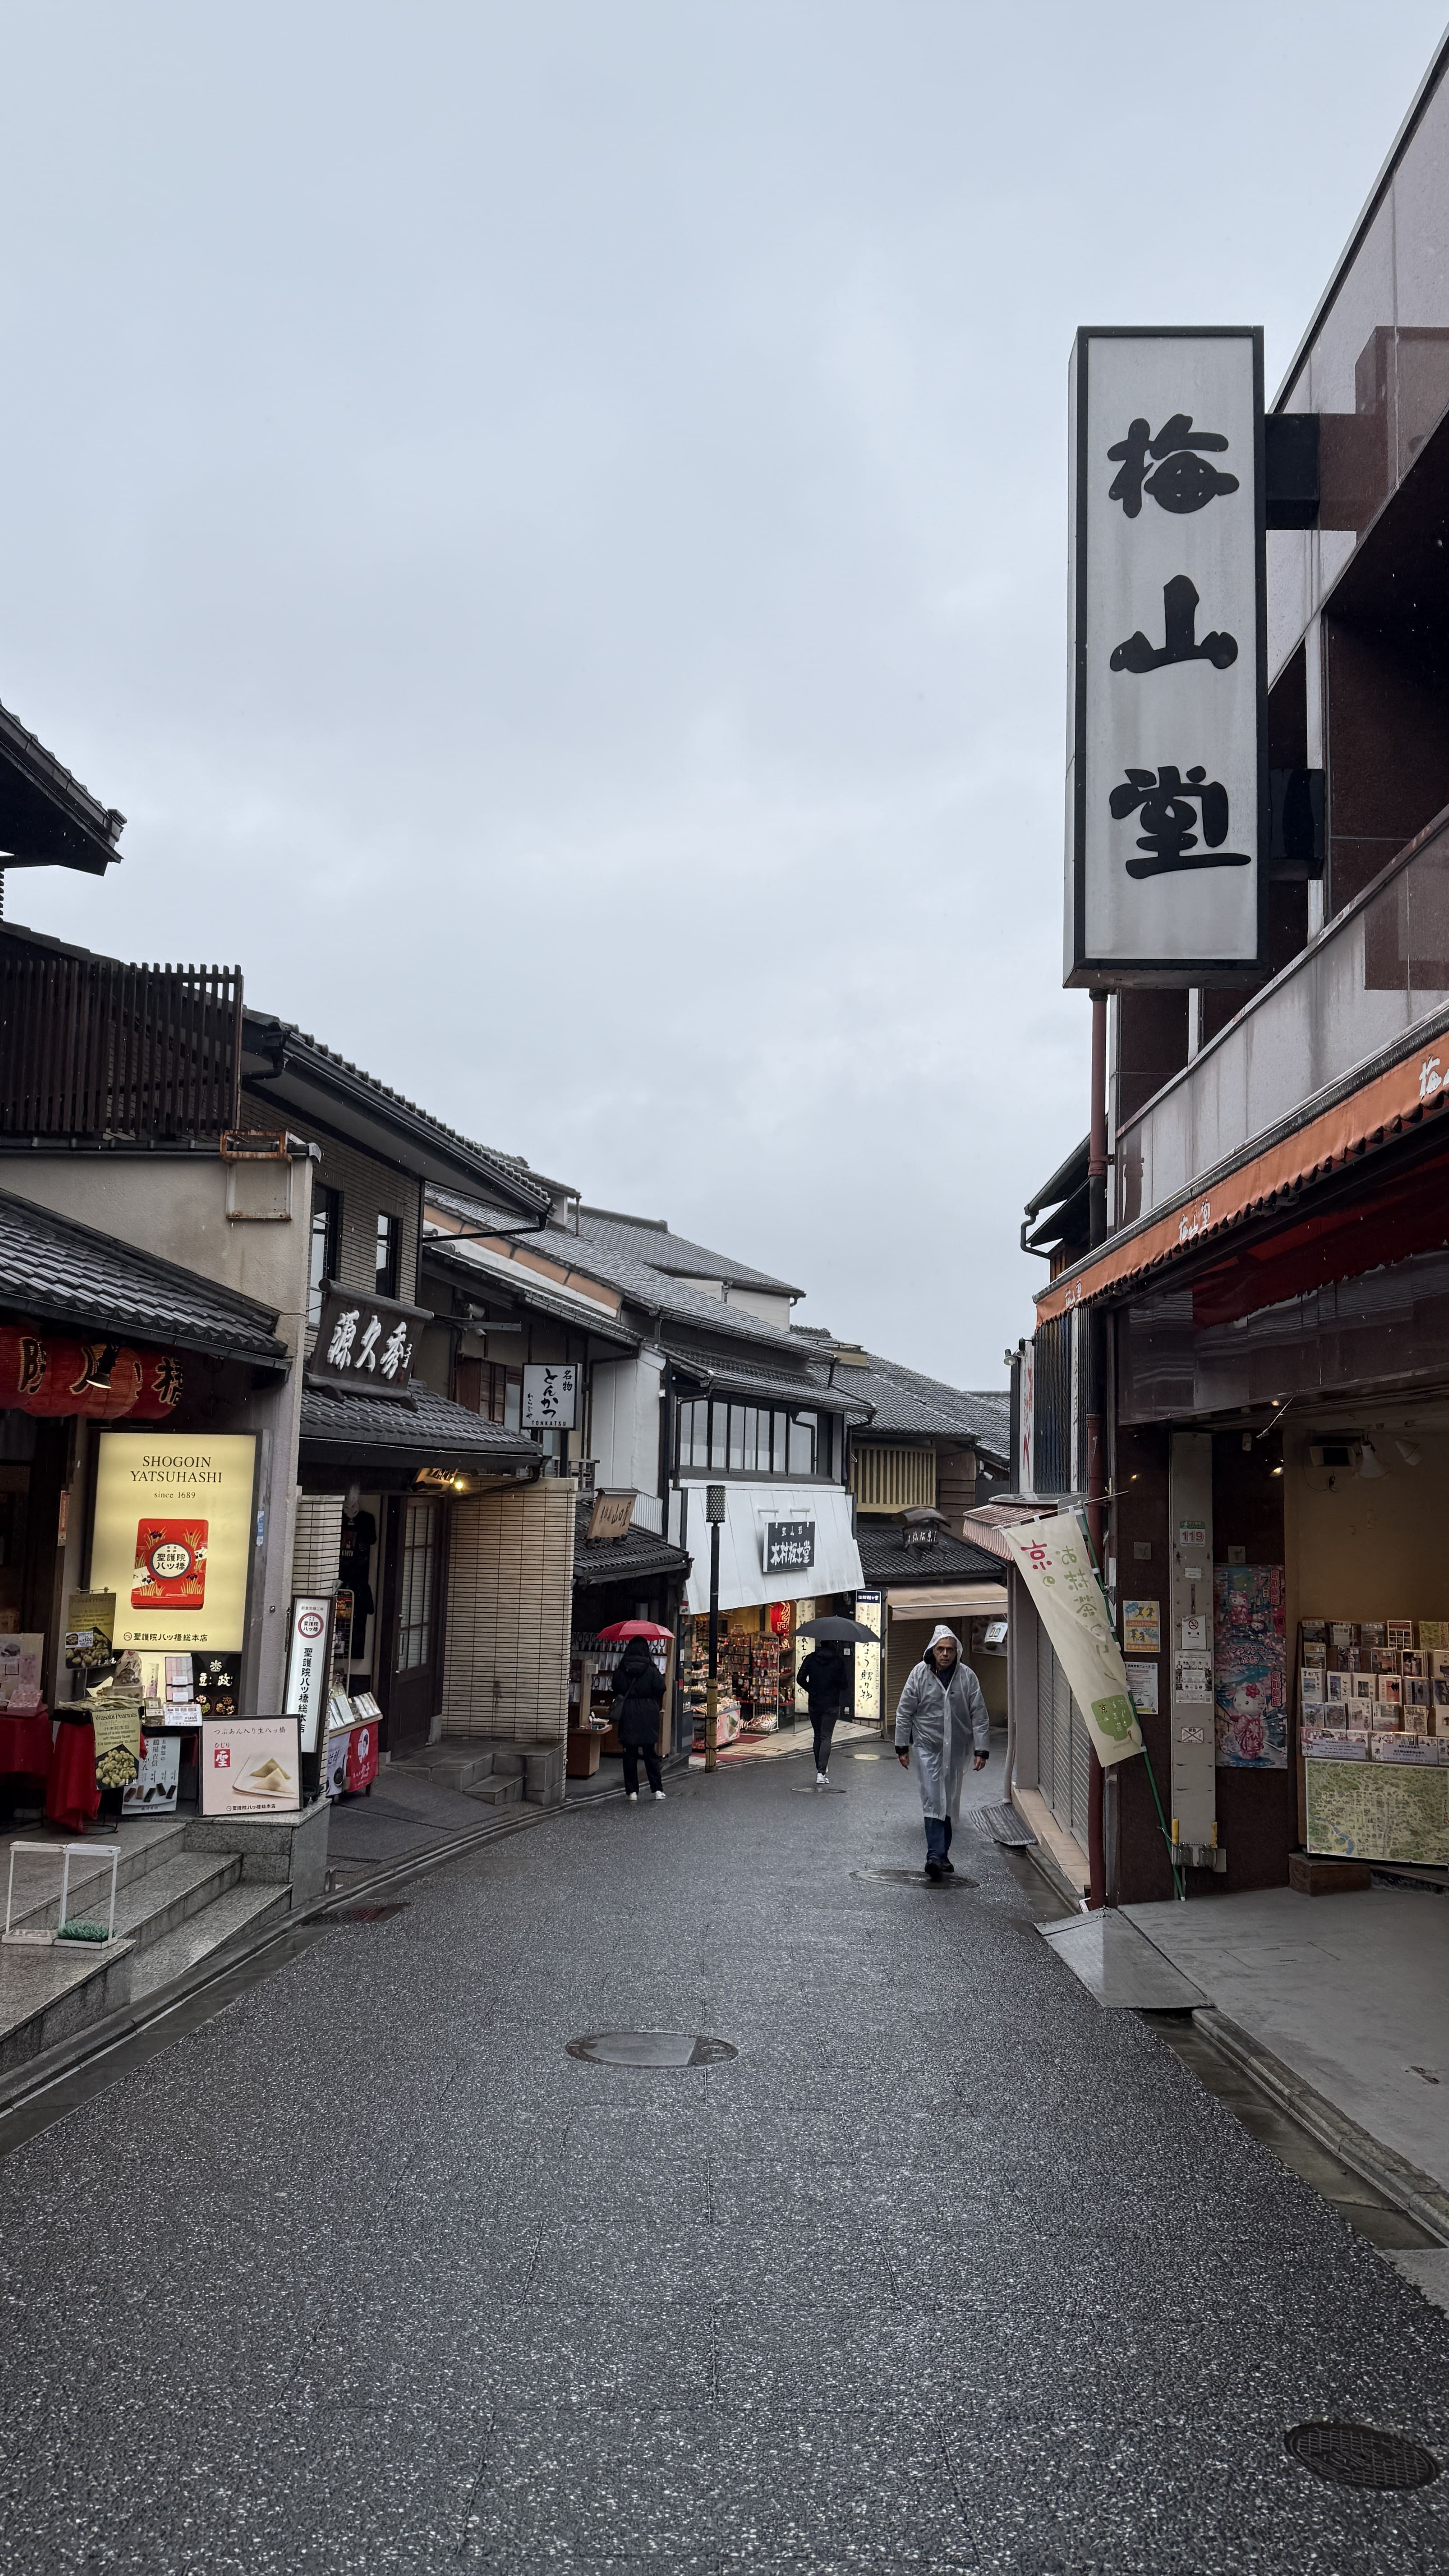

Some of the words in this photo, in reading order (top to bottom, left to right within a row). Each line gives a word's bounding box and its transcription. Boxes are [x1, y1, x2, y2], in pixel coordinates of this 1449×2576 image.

[1108, 414, 1251, 879] 梅山堂
[1419, 1055, 1449, 1099] 梅
[1179, 1199, 1211, 1241] 梅山堂
[562, 1370, 573, 1391] 名物
[541, 1368, 558, 1419] とんかつ
[143, 1456, 211, 1467] SHOGOIN
[130, 1471, 223, 1483] YATSUHASHI
[1182, 1531, 1203, 1542] 119
[157, 1553, 185, 1562] 聖護院
[1021, 1539, 1056, 1587] 京の
[133, 1633, 208, 1642] 聖護院八ツ橋総本店
[199, 1672, 232, 1687] 豆政
